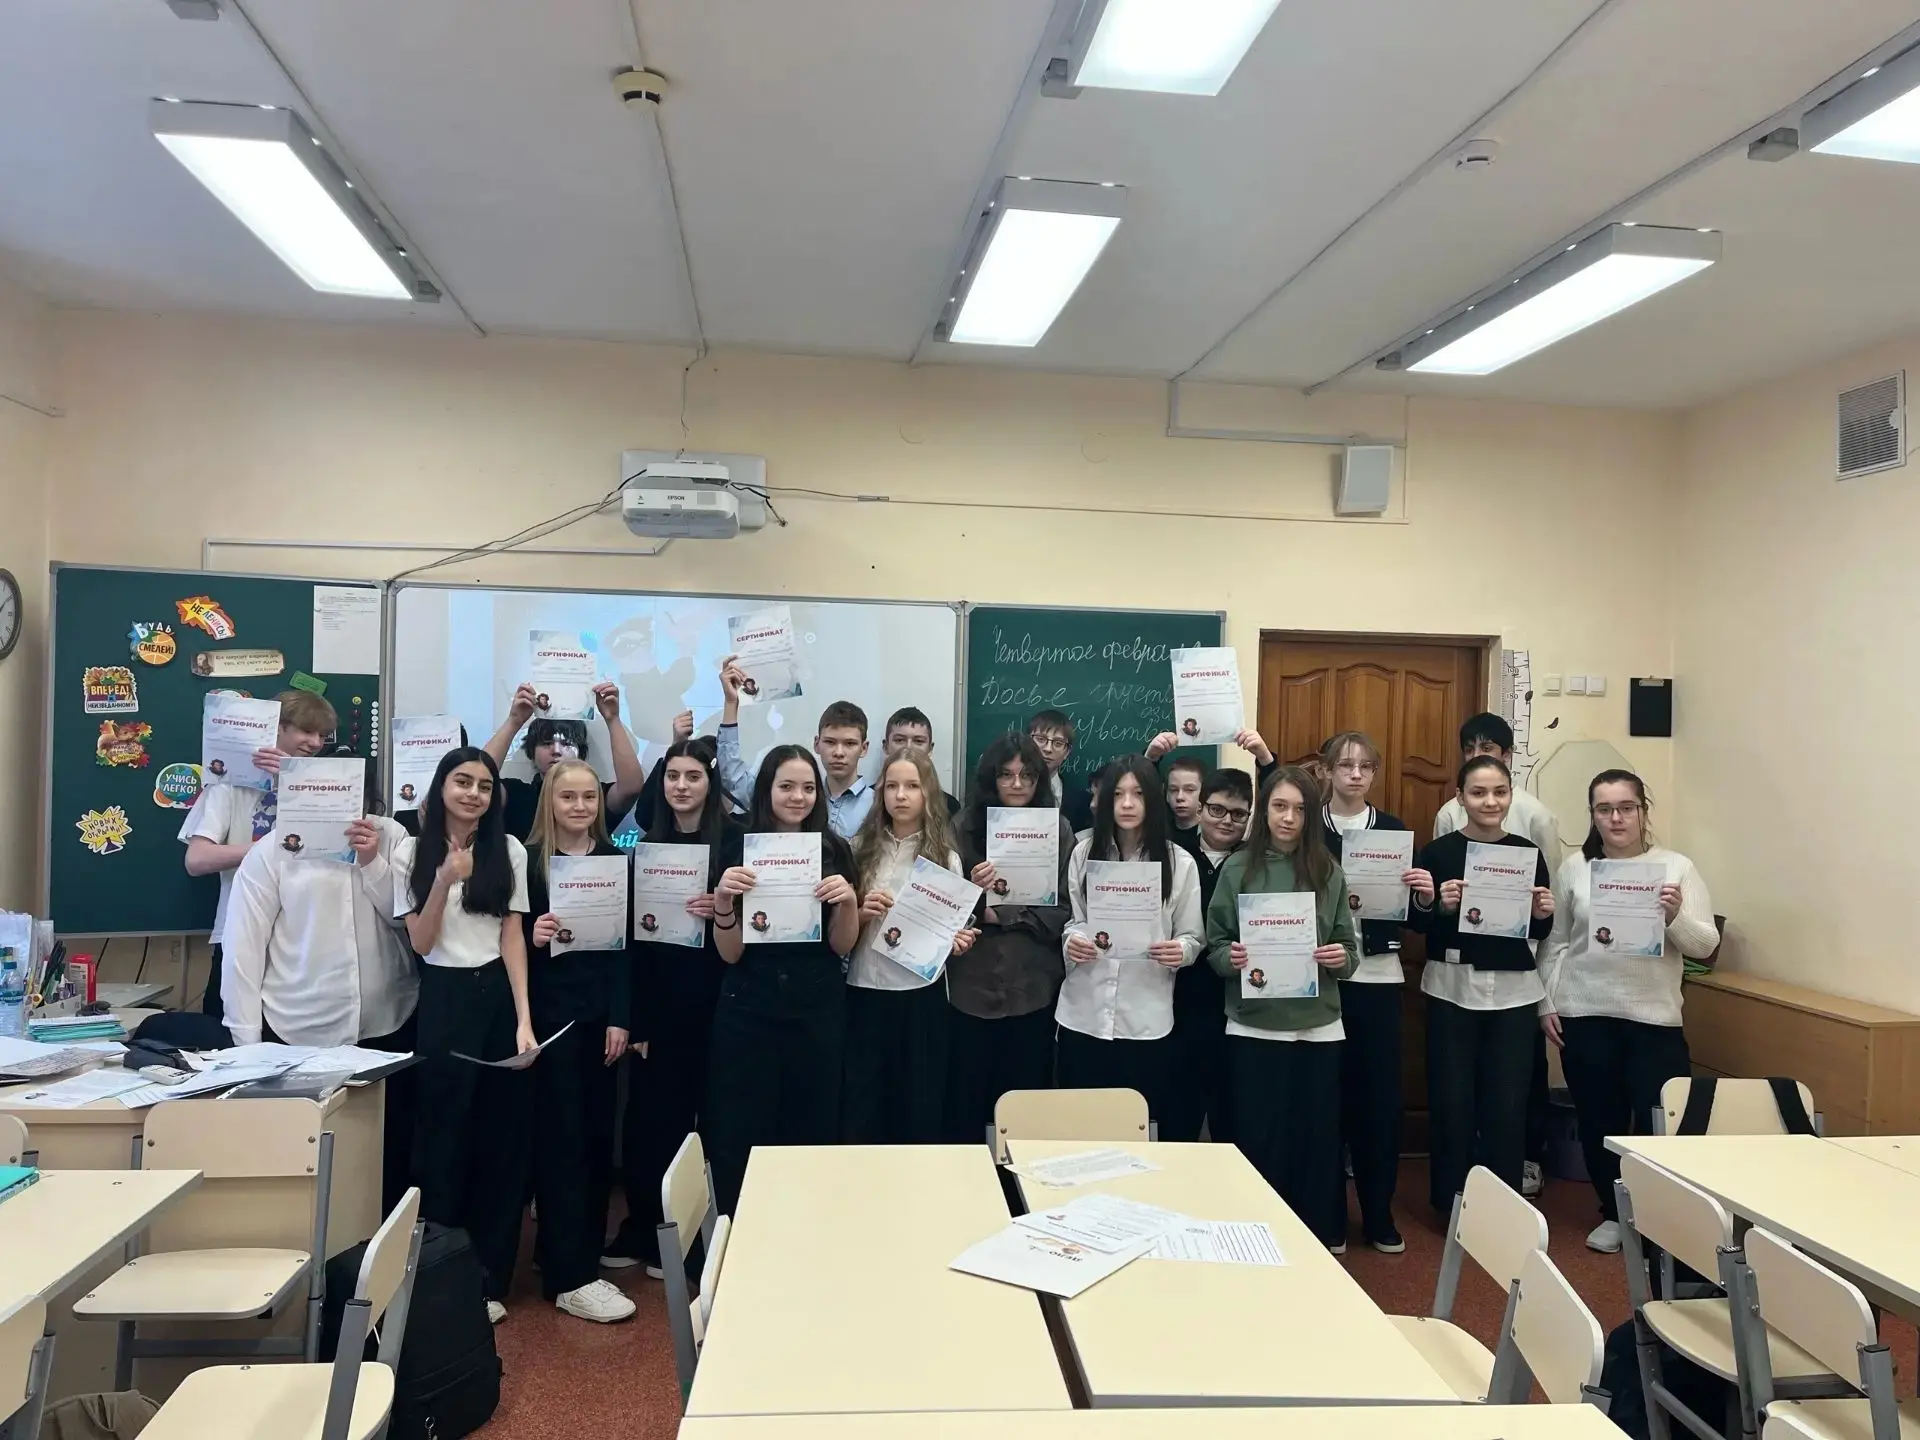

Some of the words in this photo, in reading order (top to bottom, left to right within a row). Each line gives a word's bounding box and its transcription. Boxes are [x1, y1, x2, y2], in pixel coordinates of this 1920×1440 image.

[190, 603, 204, 615] НЕ
[736, 628, 784, 642] СЕРТИФИКАТ
[993, 625, 1096, 675] Четвертое
[1103, 636, 1202, 673] февра
[1180, 670, 1230, 679] СЕРТИФИКАТ
[980, 676, 1080, 707] Досье
[212, 717, 269, 729] СЕРТИФИКАТ
[401, 738, 452, 746] СЕРТИФИКАТ
[165, 773, 198, 785] УЧИСЬ
[162, 783, 197, 795] ЛЕГКО!
[288, 784, 352, 792] СЕРТИФИКАТ
[1349, 852, 1403, 860] СЕРТИФИКАТ
[752, 858, 810, 866] СЕРТИФИКАТ
[643, 868, 698, 876] СЕРТИФИКАТ
[1473, 865, 1526, 875] СЕРТИФИКАТ
[558, 881, 617, 889] СЕРТИФИКАТ
[1095, 885, 1151, 893] СЕРТИФИКАТ
[1598, 883, 1655, 892] СЕРТИФИКАТ
[911, 882, 962, 912] СЕРТИФИКАТ
[1248, 918, 1306, 926] СЕРТИФИКАТ
